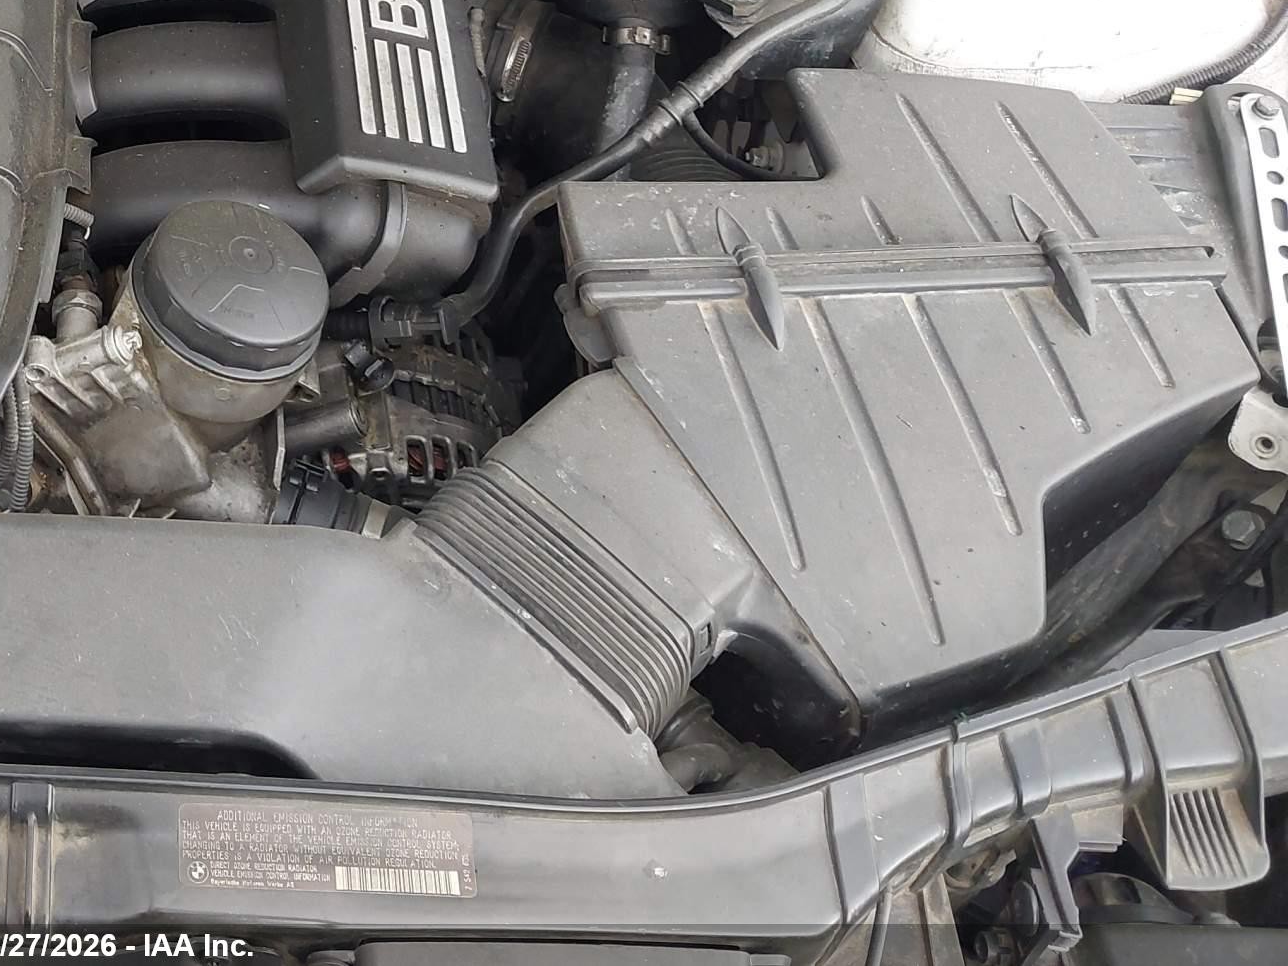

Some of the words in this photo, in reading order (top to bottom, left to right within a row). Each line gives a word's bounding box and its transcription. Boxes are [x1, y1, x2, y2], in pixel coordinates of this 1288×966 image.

[217, 809, 268, 823] ADDITIONAL
[273, 812, 313, 824] EMISSION
[318, 813, 354, 826] CONTROL
[361, 817, 418, 828] INFORMION
[182, 819, 200, 830] THIS
[204, 820, 238, 832] VEHICLE
[242, 822, 251, 832] IS
[255, 822, 292, 834] EQUIPPED
[296, 824, 317, 835] WITH
[320, 825, 332, 835] AN
[335, 826, 360, 836] OZONE
[411, 828, 452, 840] RADIATOR
[182, 830, 202, 840] THAT
[207, 831, 215, 841] IS
[219, 832, 231, 841] AN
[234, 832, 269, 843] ELEMENT
[288, 834, 303, 844] THE
[307, 835, 342, 846] VEHICLE
[182, 840, 221, 851] CHANGING
[225, 841, 234, 851] TO
[294, 844, 326, 855] WITHOUT
[414, 849, 458, 860] REDUCTION
[182, 849, 229, 860] PROPERTIES
[235, 852, 242, 861] IS
[257, 853, 300, 863] VIOLATION
[319, 855, 333, 865] AIR
[337, 855, 381, 867] POLLUTION
